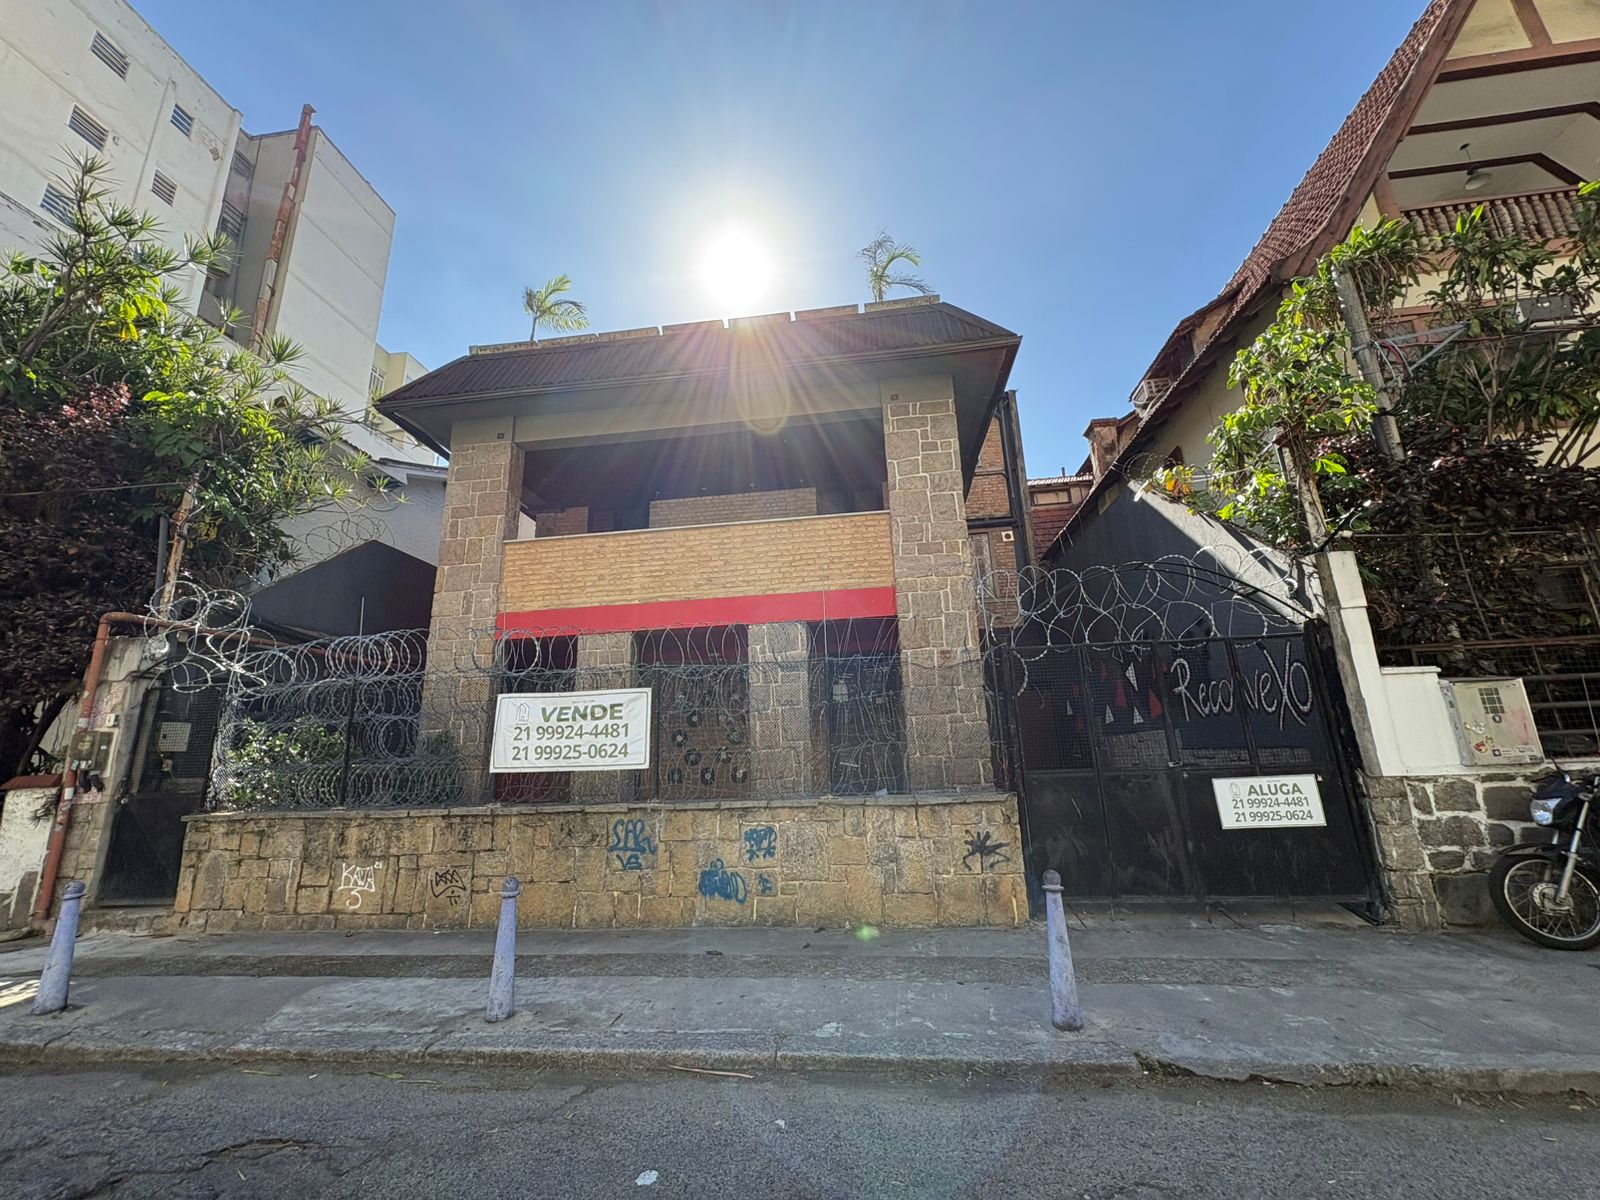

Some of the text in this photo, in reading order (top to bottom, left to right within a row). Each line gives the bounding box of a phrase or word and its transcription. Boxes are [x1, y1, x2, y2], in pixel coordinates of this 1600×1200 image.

[541, 703, 624, 723] VENDE
[513, 722, 630, 741] 21 99924-4481
[511, 743, 629, 761] 21 99925-0624
[1247, 782, 1304, 796] ALUGA
[1232, 796, 1310, 809] 21 99924-4481
[1234, 810, 1313, 822] 21 99925-0624
